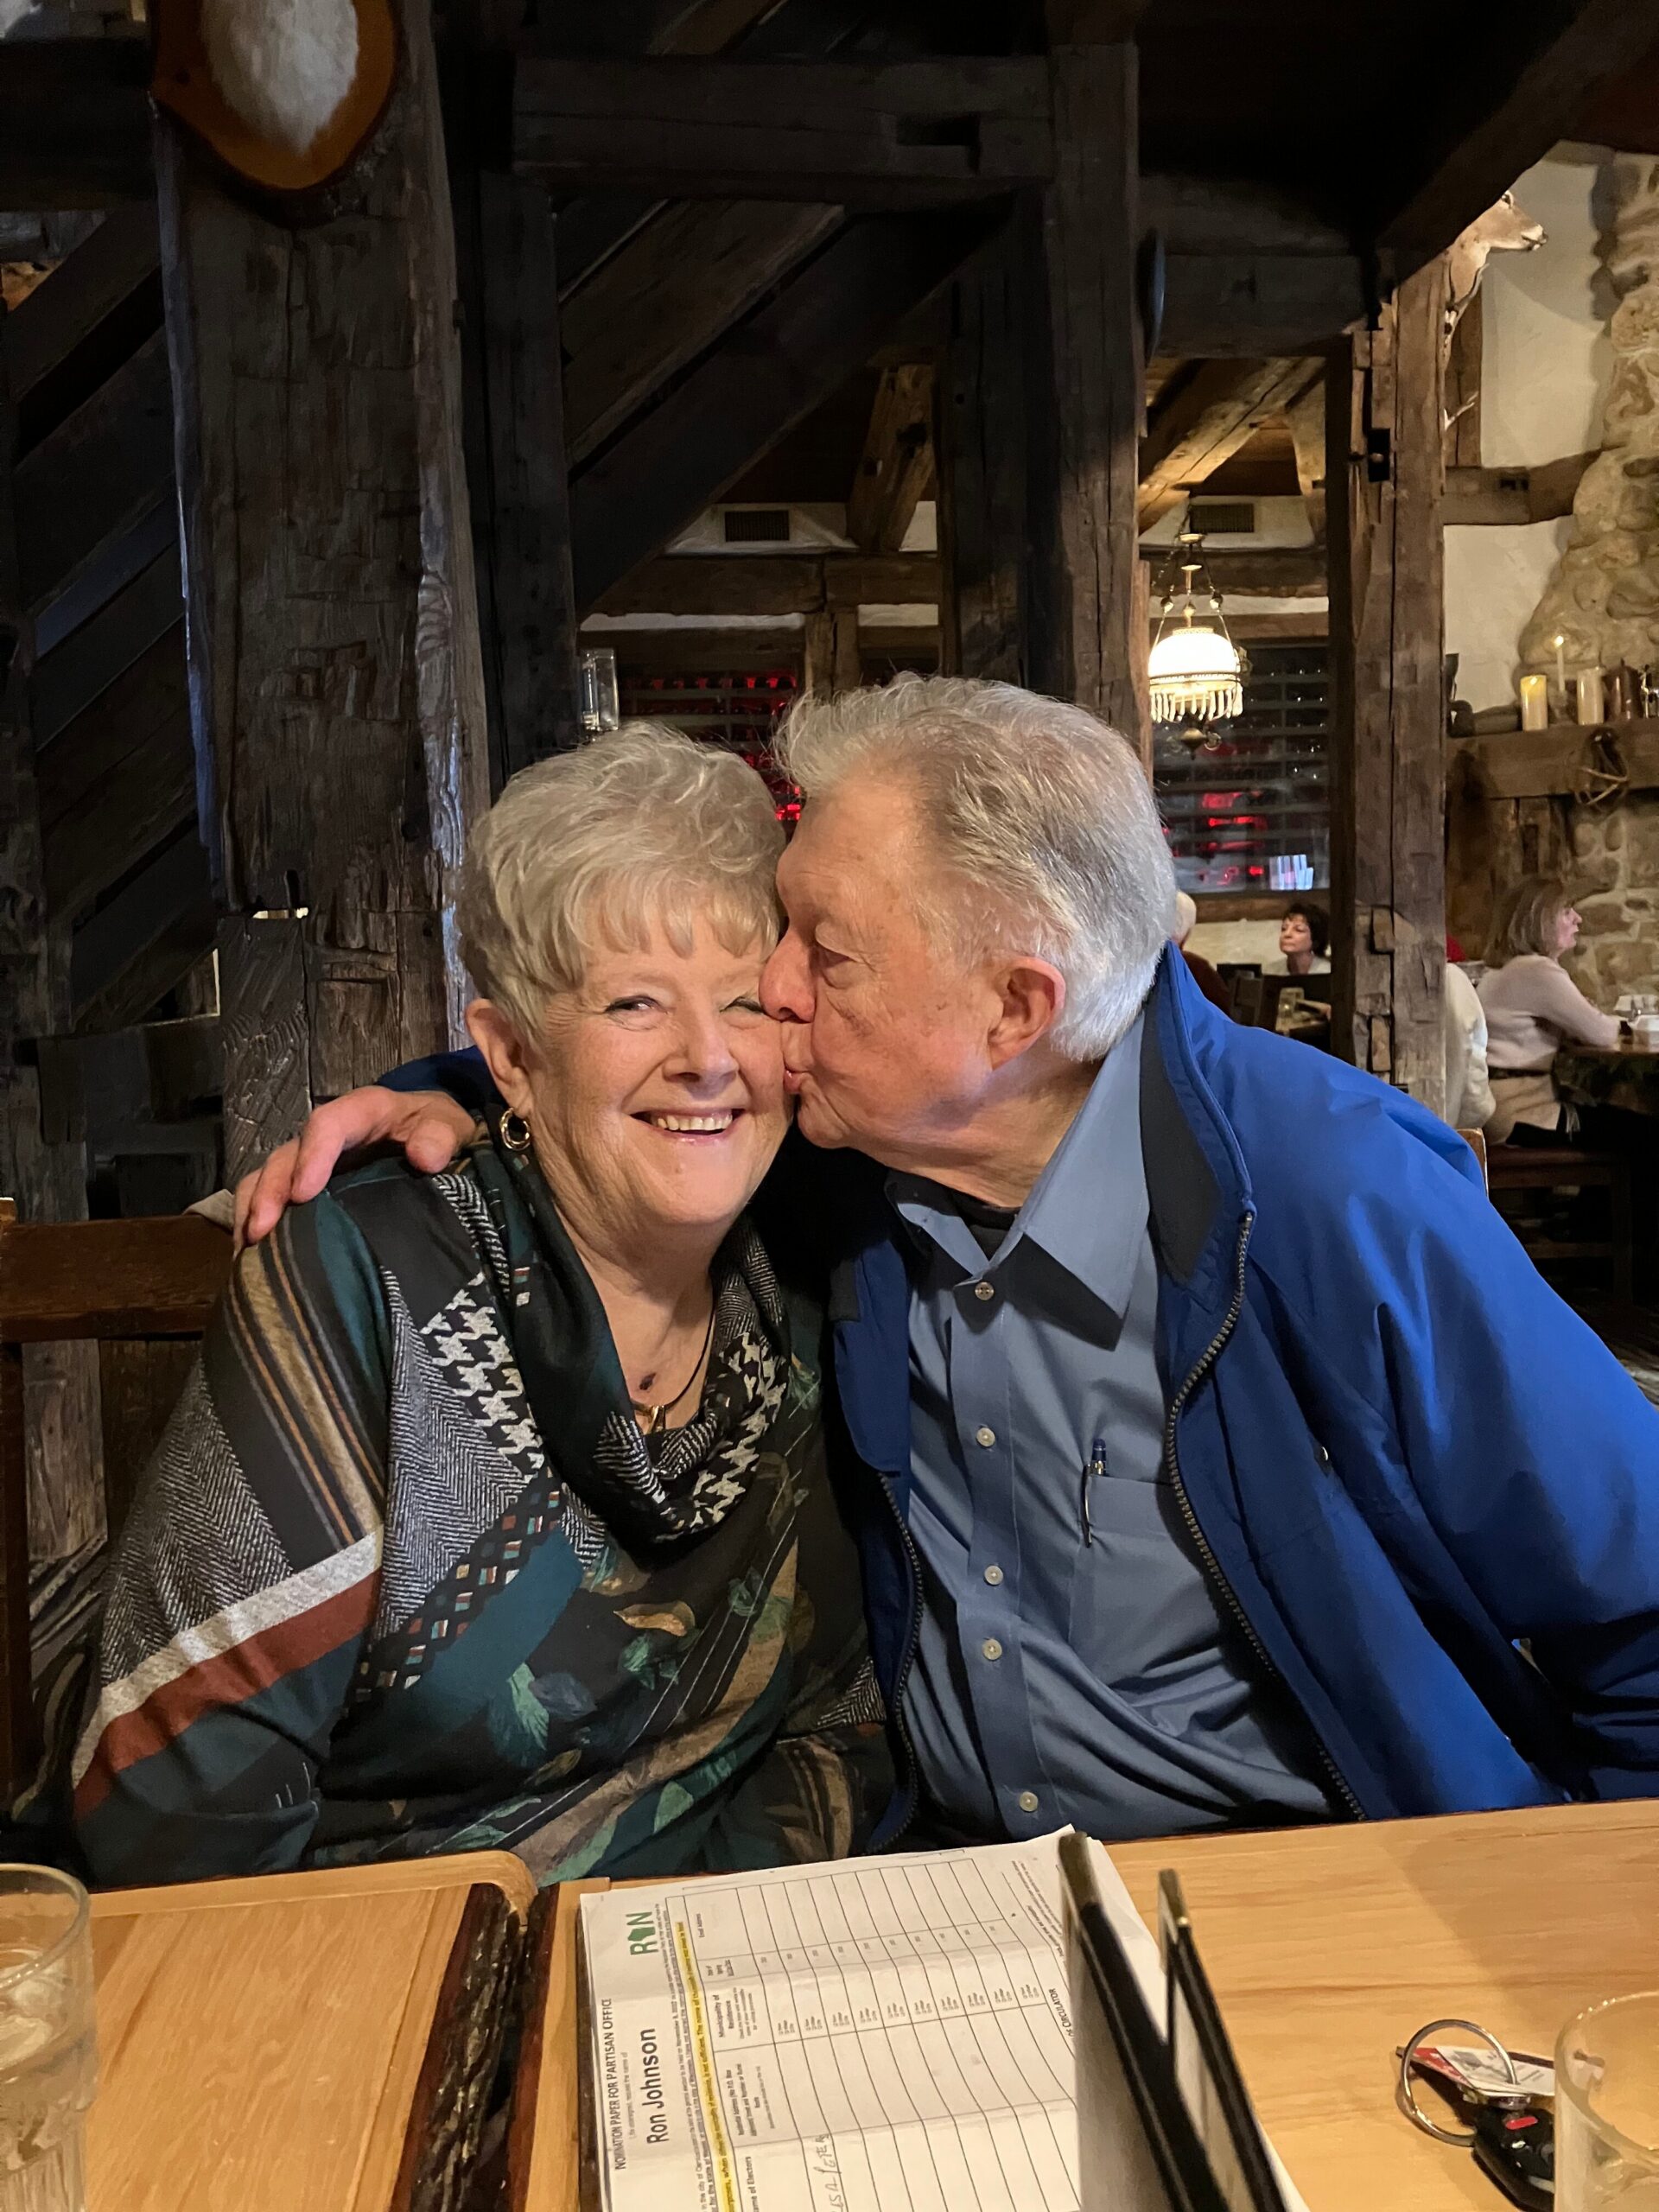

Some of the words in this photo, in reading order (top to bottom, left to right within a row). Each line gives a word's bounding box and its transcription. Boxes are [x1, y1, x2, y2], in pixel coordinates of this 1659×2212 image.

[601, 1999, 613, 2029] OFFICE
[1047, 1987, 1071, 2028] CIRCULATOR
[602, 2032, 617, 2080] PARTISAN
[639, 2028, 665, 2109] Johnson
[607, 2082, 619, 2098] FOR
[609, 2100, 621, 2125] PAPER
[645, 2113, 670, 2144] Ron
[744, 2156, 754, 2184] Electors
[752, 2196, 760, 2212] ame
